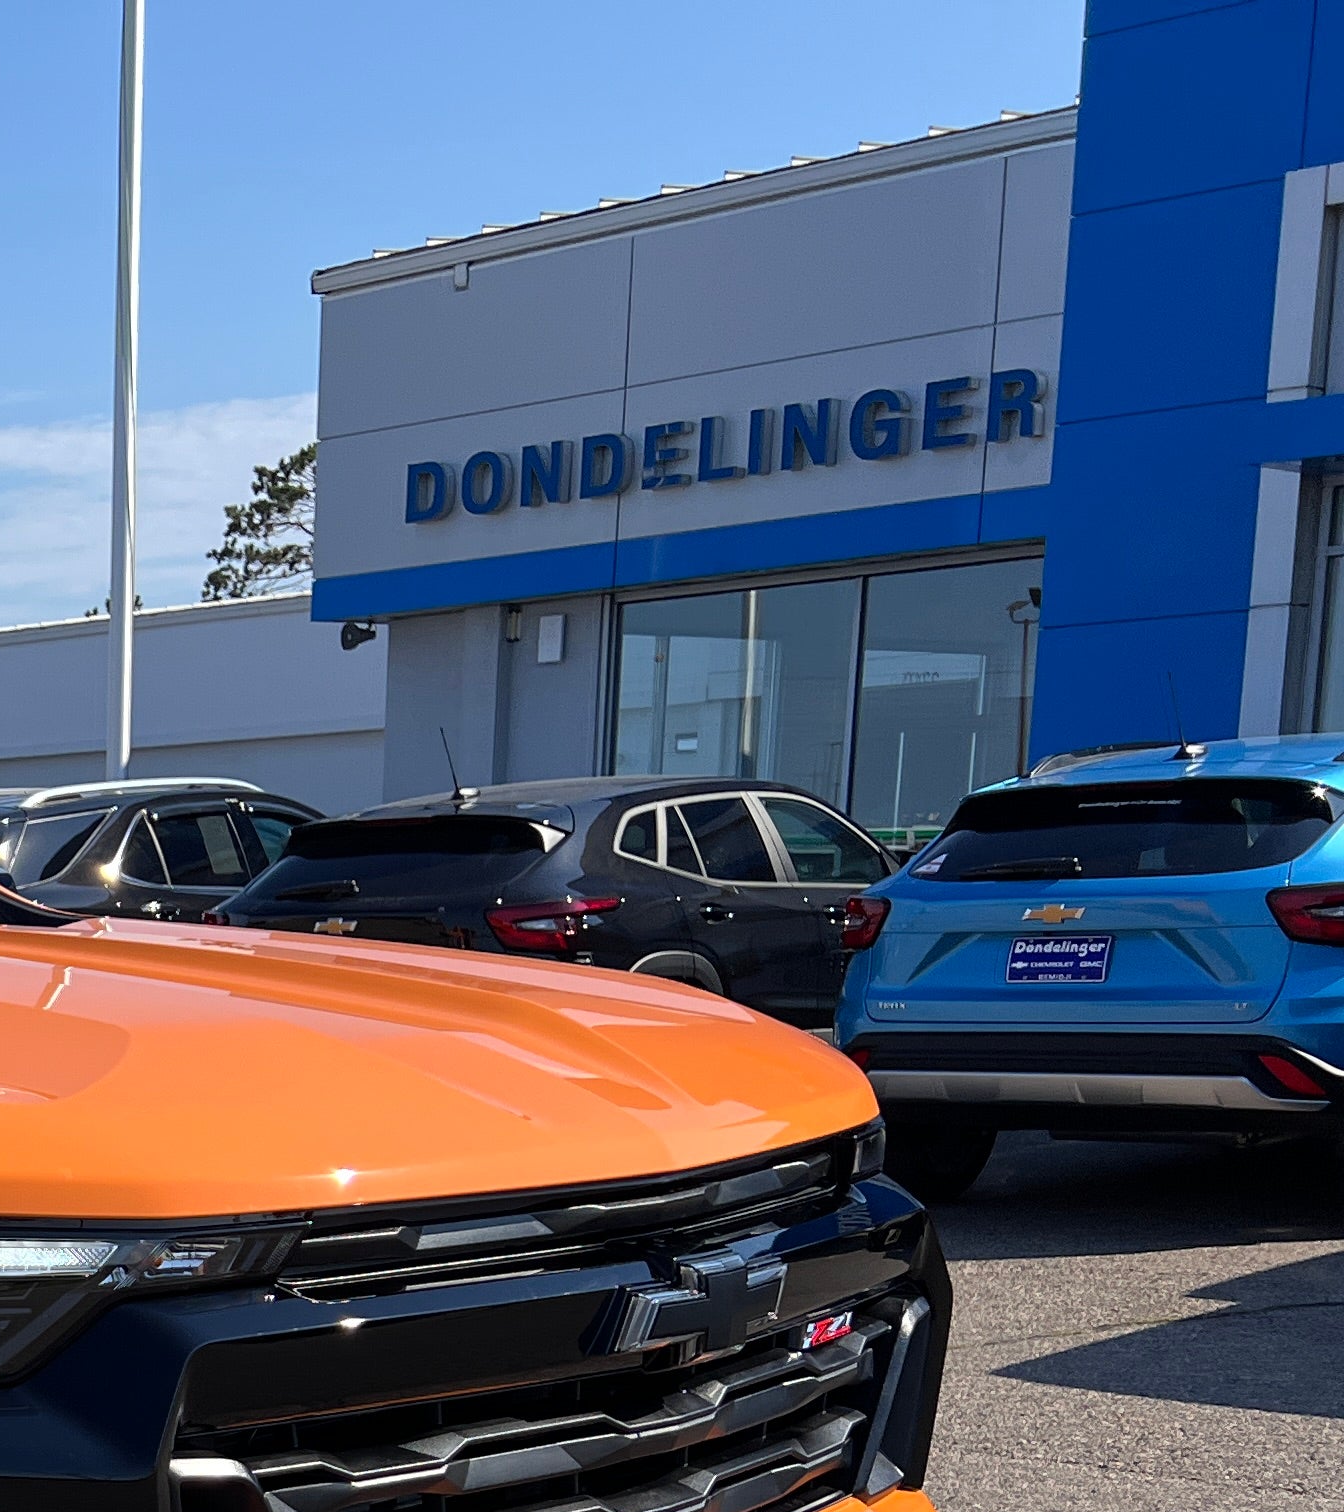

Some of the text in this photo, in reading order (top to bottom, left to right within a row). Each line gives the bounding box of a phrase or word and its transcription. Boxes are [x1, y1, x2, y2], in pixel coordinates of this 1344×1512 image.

[405, 368, 1047, 525] DONDELINGER
[1014, 941, 1106, 957] Dondelinger
[1079, 960, 1104, 968] GMC
